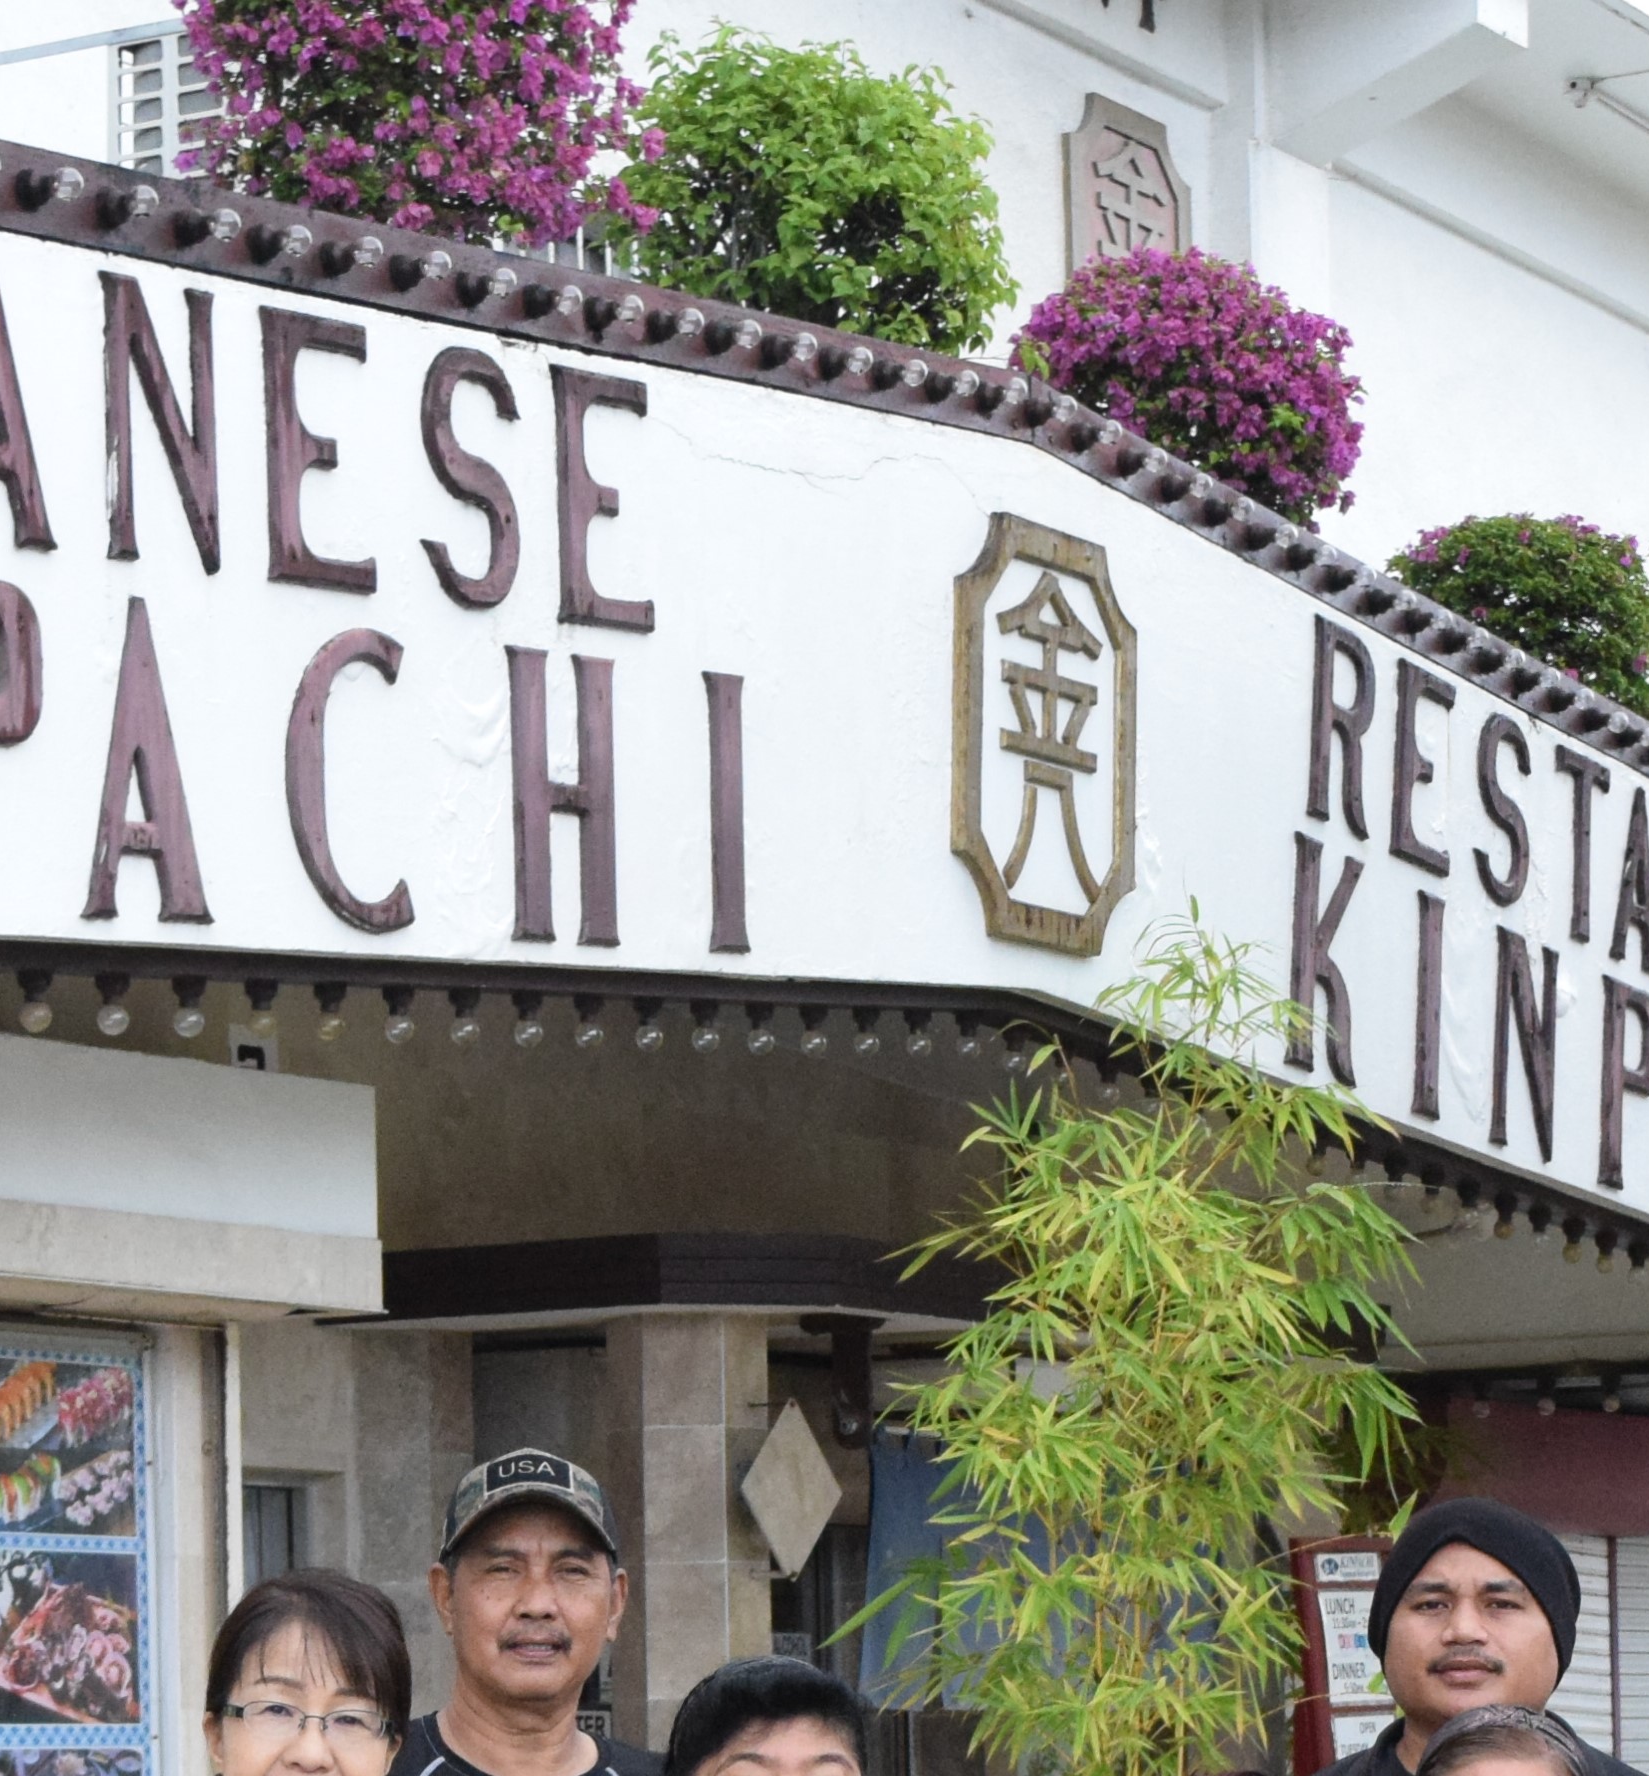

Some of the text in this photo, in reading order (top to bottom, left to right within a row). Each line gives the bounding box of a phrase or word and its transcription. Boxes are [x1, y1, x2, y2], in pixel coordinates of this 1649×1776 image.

[996, 570, 1103, 904] 金八
[498, 1460, 556, 1478] USA
[1325, 1597, 1356, 1615] LUNCH
[1332, 1661, 1367, 1680] DINNER
[1359, 1721, 1377, 1734] OPEN
